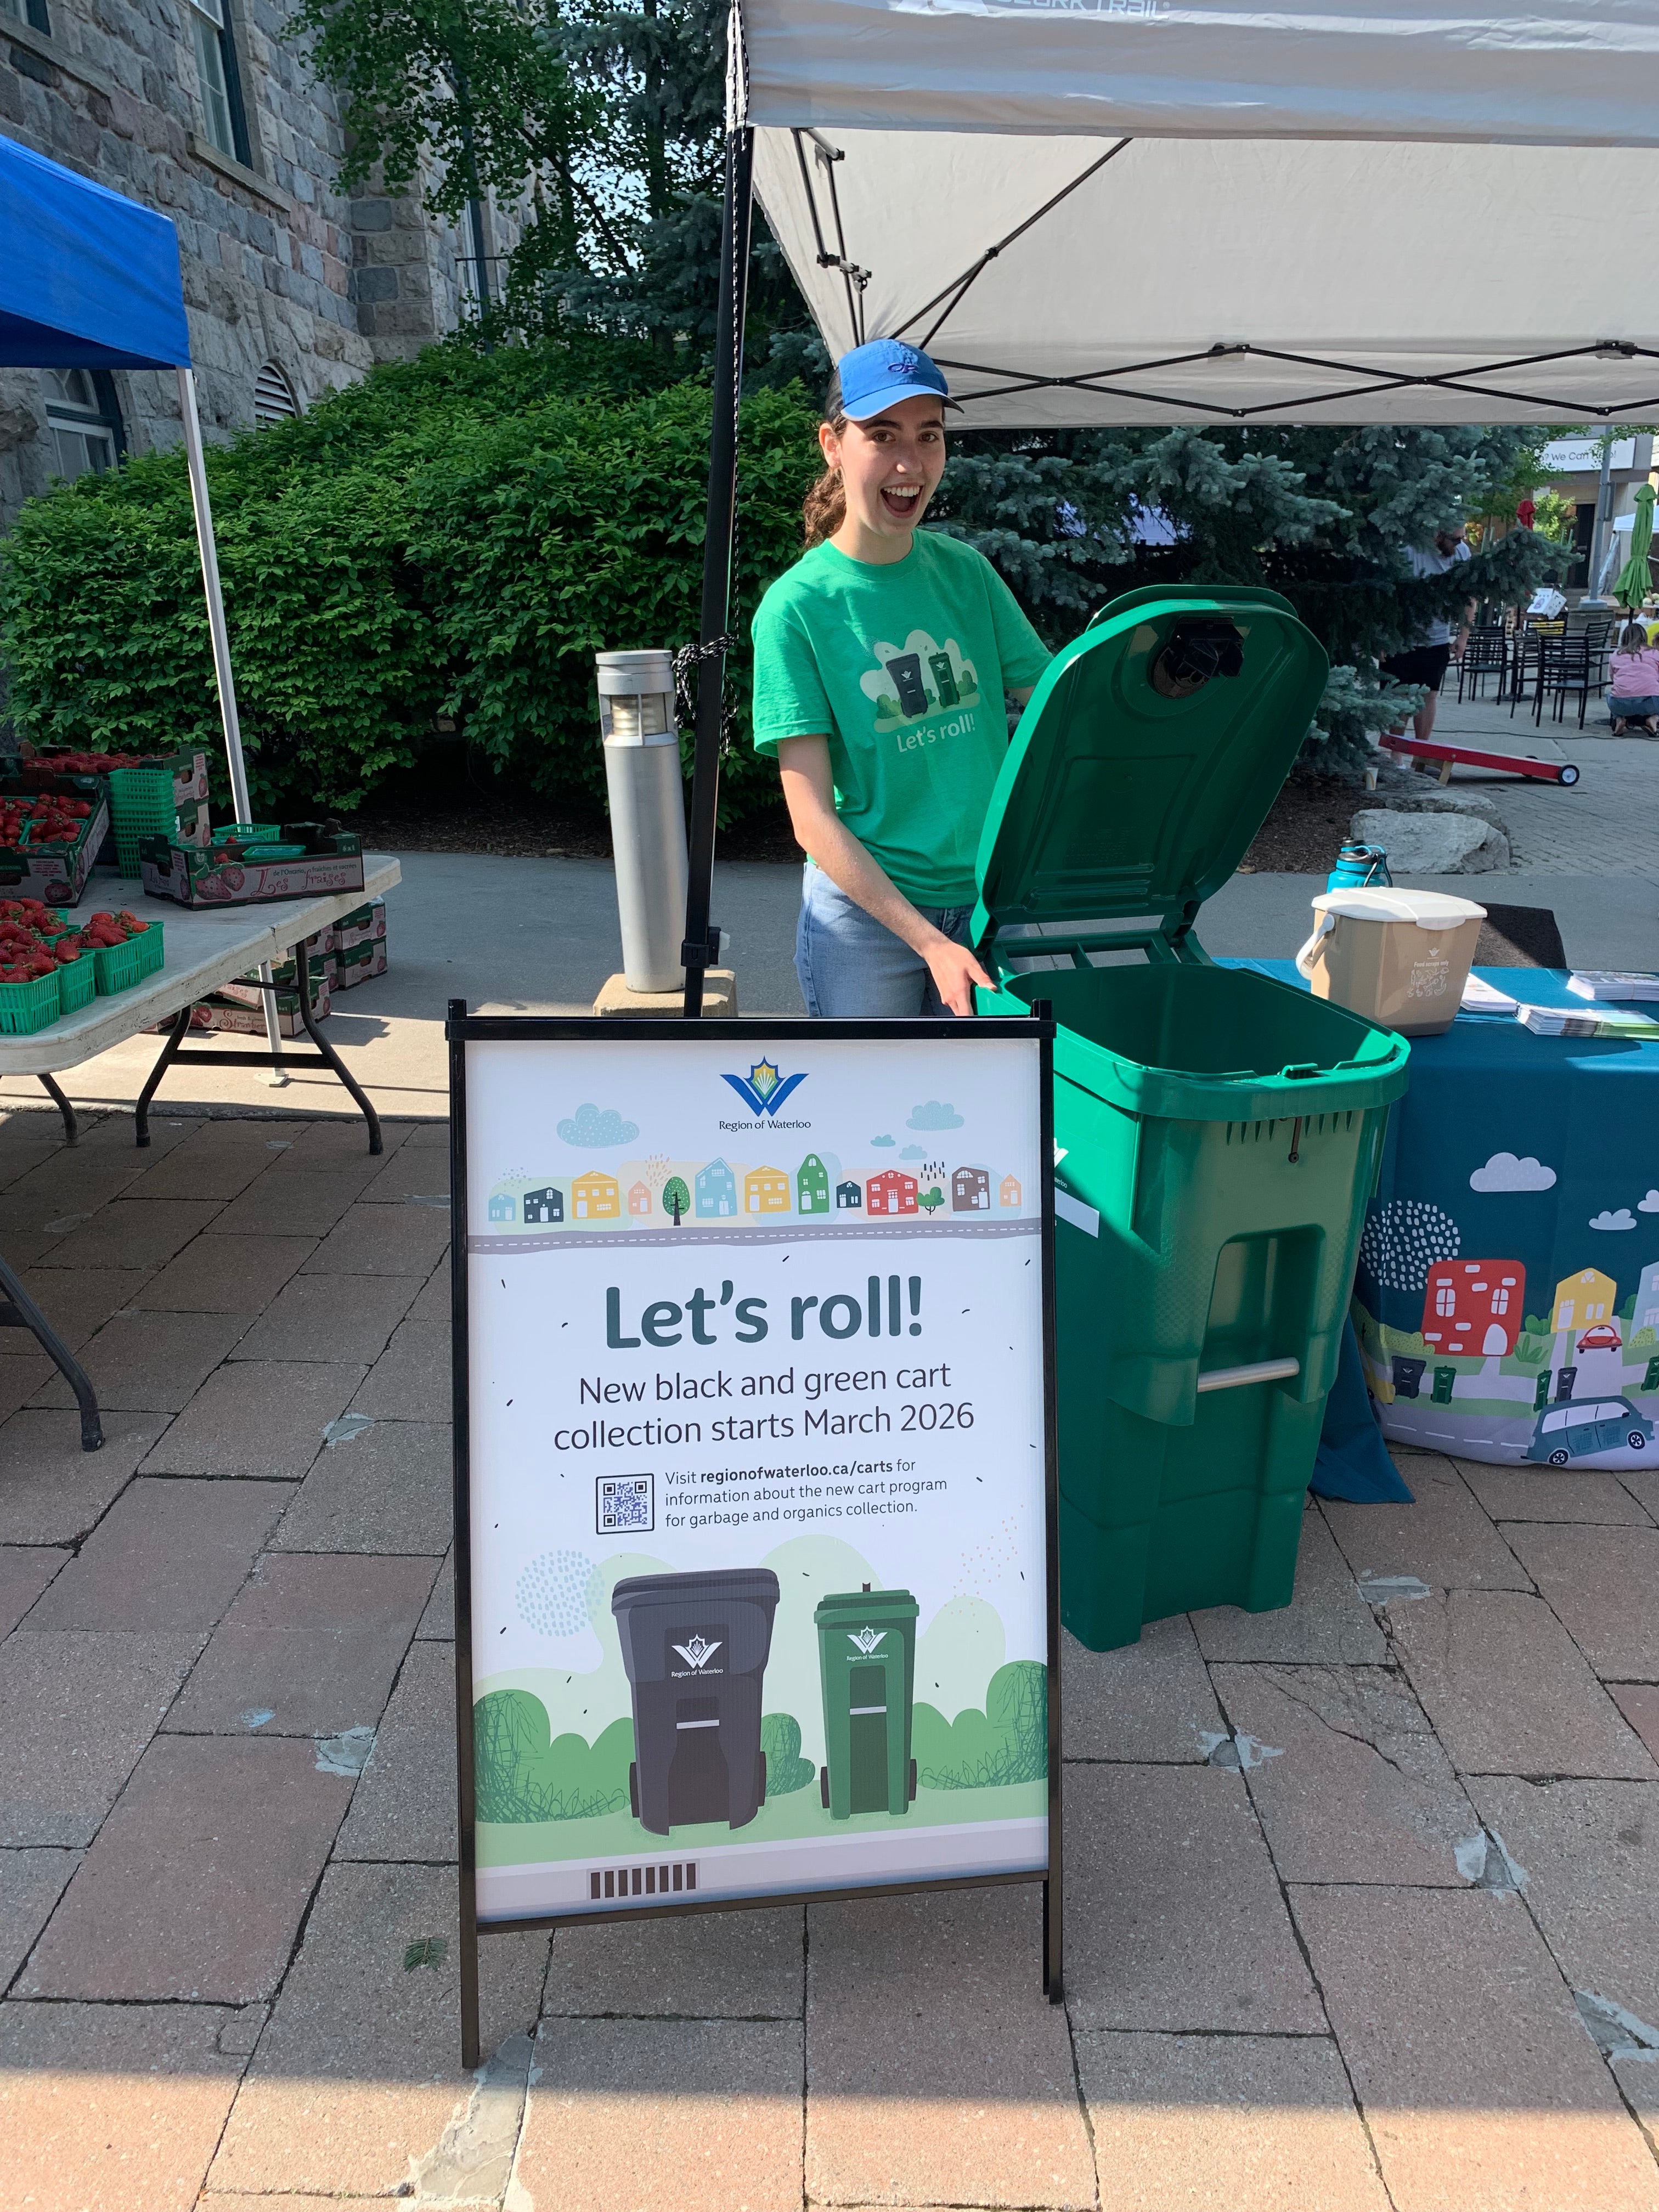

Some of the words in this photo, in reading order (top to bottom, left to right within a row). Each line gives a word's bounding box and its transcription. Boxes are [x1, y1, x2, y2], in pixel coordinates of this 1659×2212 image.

[896, 726, 936, 753] Let's
[940, 713, 975, 740] roll!
[250, 867, 289, 896] Les
[302, 869, 346, 890] fraises
[719, 1120, 752, 1132] Region
[754, 1120, 765, 1129] of
[768, 1119, 811, 1129] Waterloo
[606, 1279, 769, 1349] Let's
[791, 1274, 922, 1341] roll!
[580, 1376, 646, 1405] New
[656, 1370, 733, 1401] black
[741, 1367, 794, 1396] and
[804, 1370, 886, 1401] green
[896, 1363, 952, 1389] cart
[554, 1417, 701, 1451] collection
[712, 1413, 794, 1441] starts
[805, 1406, 890, 1436] March
[900, 1402, 974, 1431] 2026
[665, 1471, 697, 1485] Visit
[701, 1460, 893, 1485] regionofwaterloo.ca/carts
[896, 1458, 916, 1472] for
[665, 1489, 749, 1506] information
[753, 1486, 795, 1500] about
[799, 1485, 822, 1498] the
[826, 1485, 854, 1496] new
[858, 1481, 885, 1494] cart
[889, 1480, 947, 1496] program
[665, 1514, 685, 1527] for
[690, 1511, 749, 1529] garbage
[753, 1507, 779, 1521] and
[783, 1504, 842, 1522] organics
[846, 1500, 918, 1516] collection.
